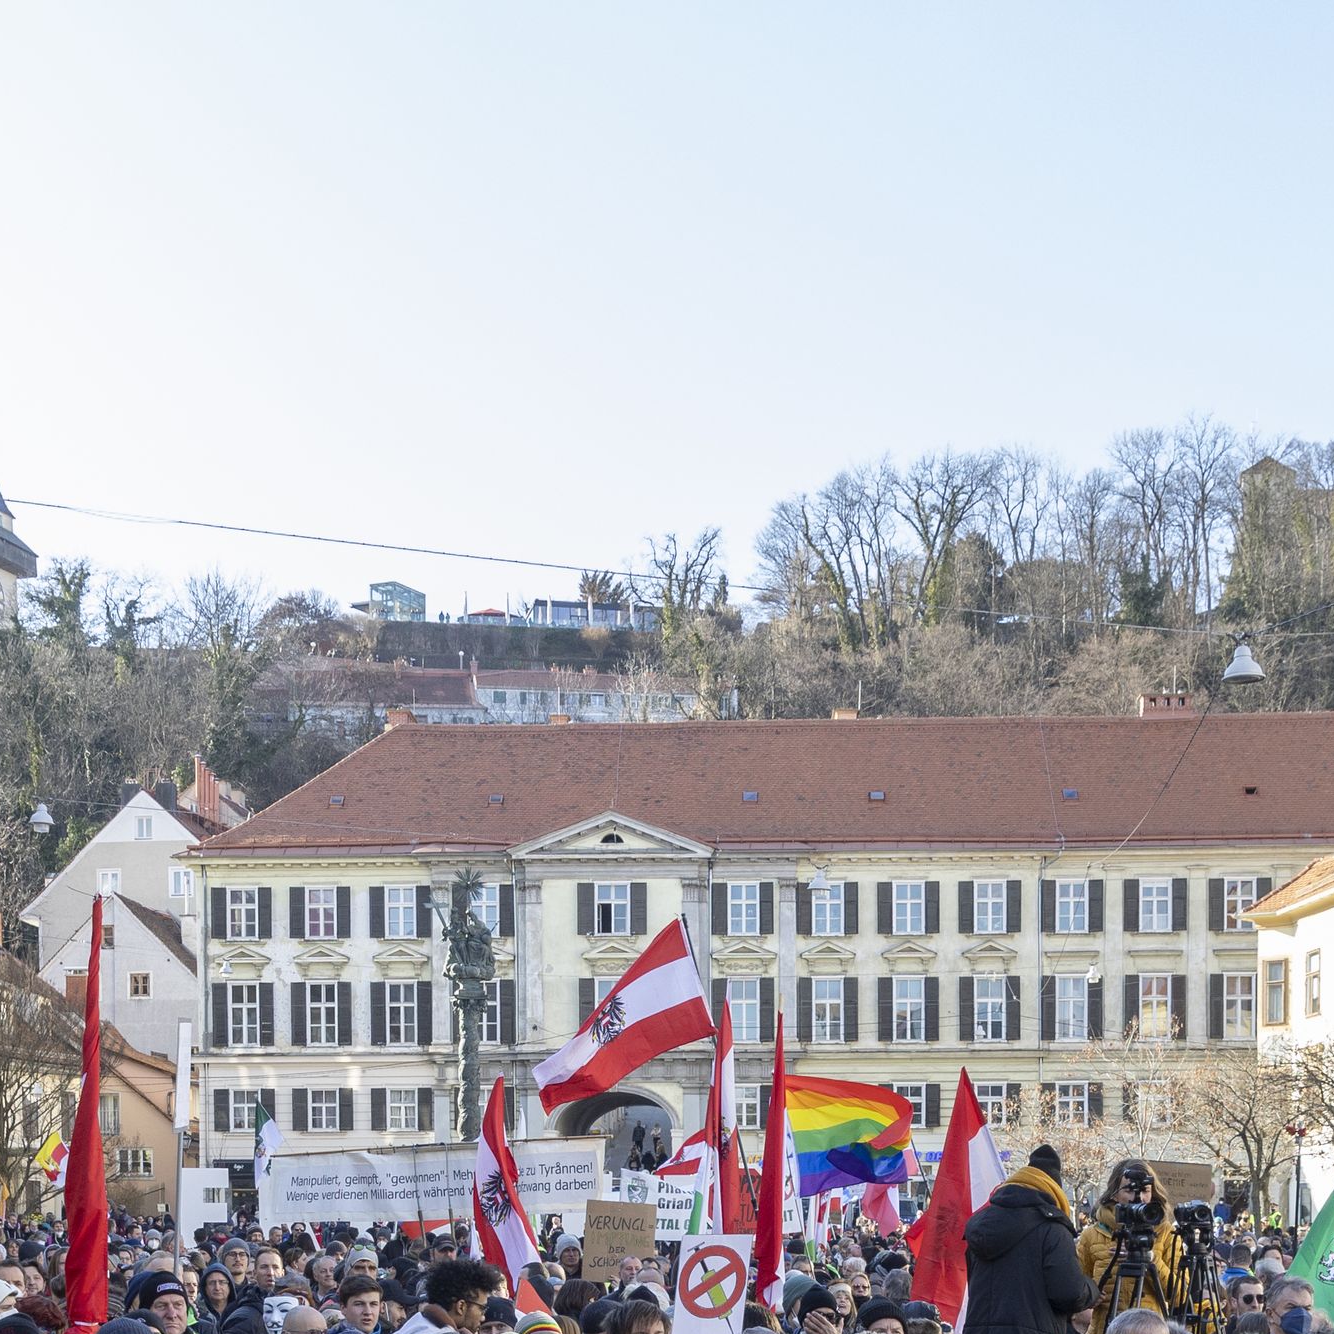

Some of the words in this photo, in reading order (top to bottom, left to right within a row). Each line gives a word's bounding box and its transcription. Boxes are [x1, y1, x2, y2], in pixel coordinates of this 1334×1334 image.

[291, 1175, 341, 1187] Manipuliert,
[345, 1174, 382, 1187] geimpft,
[526, 1165, 536, 1176] zu
[286, 1190, 318, 1203] Wenige
[322, 1189, 367, 1201] verdienen
[370, 1188, 420, 1200] Milliarden,
[423, 1186, 465, 1198] während
[555, 1178, 596, 1191] darben!
[608, 1246, 626, 1254] DER
